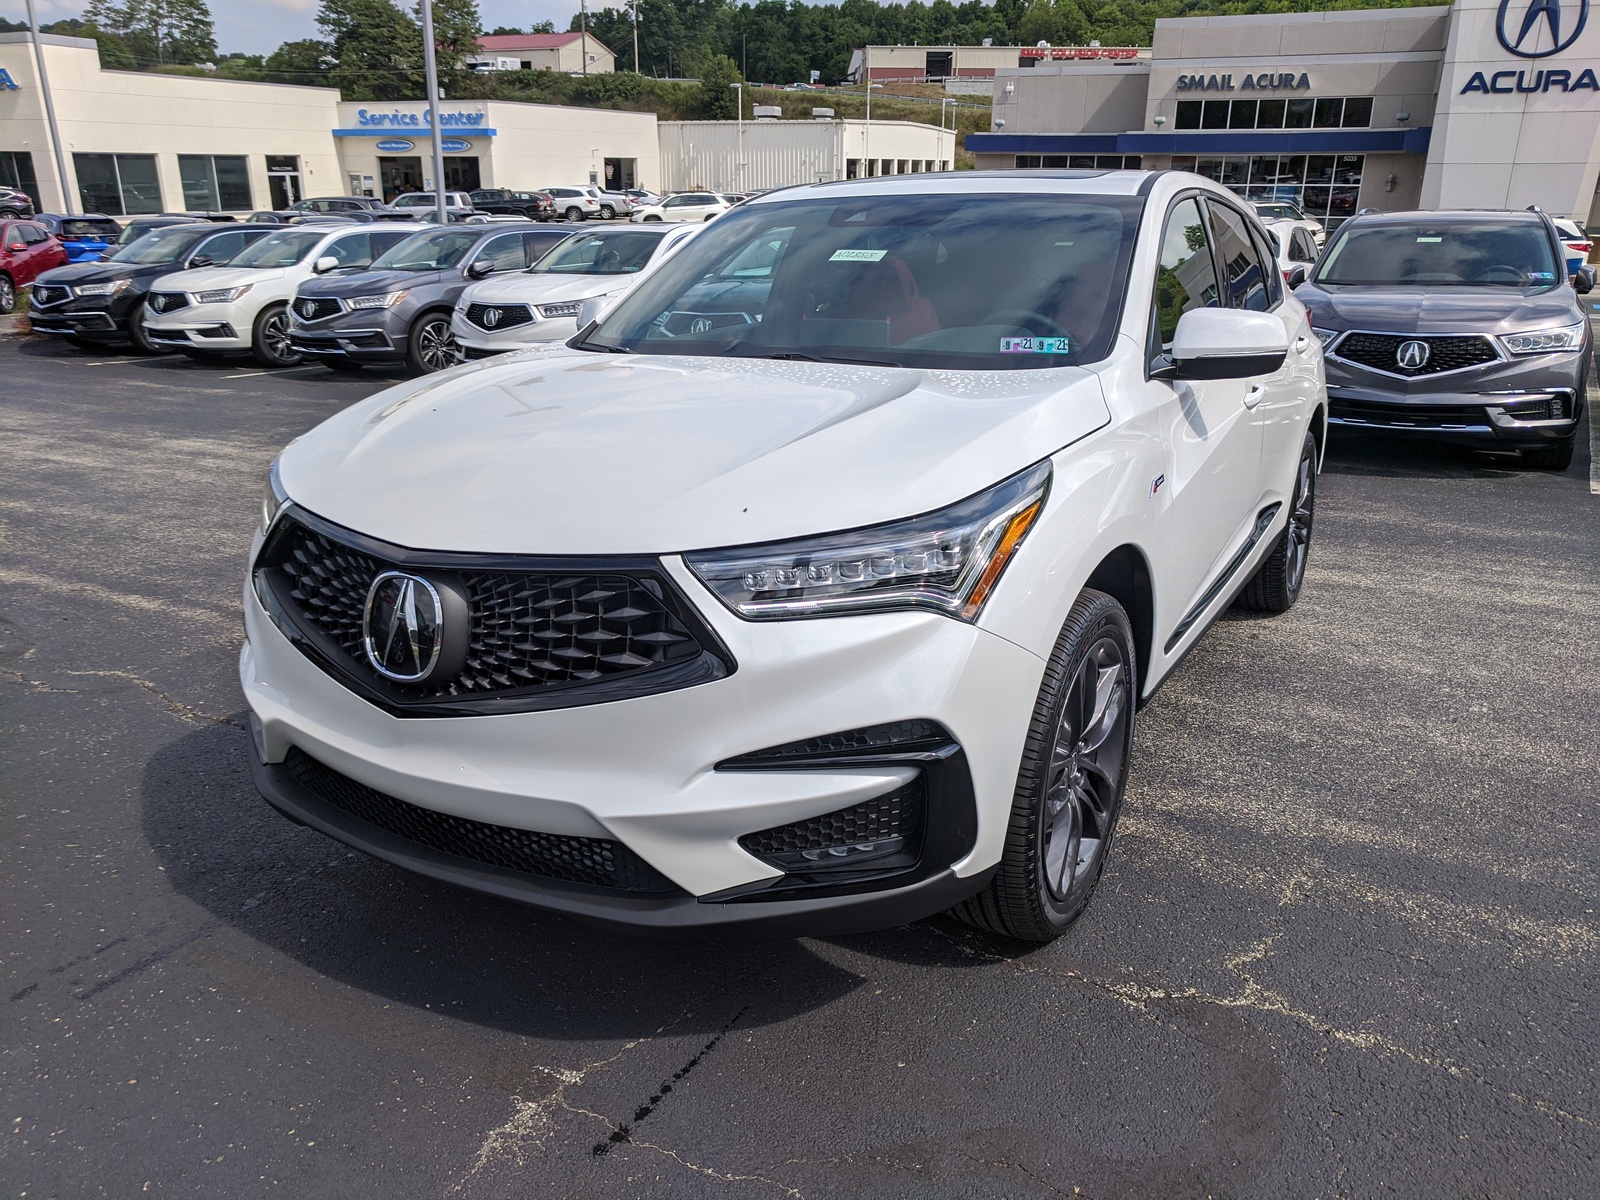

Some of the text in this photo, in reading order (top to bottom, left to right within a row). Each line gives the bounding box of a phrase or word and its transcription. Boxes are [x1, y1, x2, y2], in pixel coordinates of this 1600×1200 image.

[1021, 48, 1138, 58] SMAIL COLLISION CENTER
[1176, 72, 1311, 91] SMAIL ACURA
[1460, 68, 1600, 94] ACURA
[357, 108, 419, 126] Service
[1023, 338, 1033, 350] 21
[1057, 339, 1067, 351] 21
